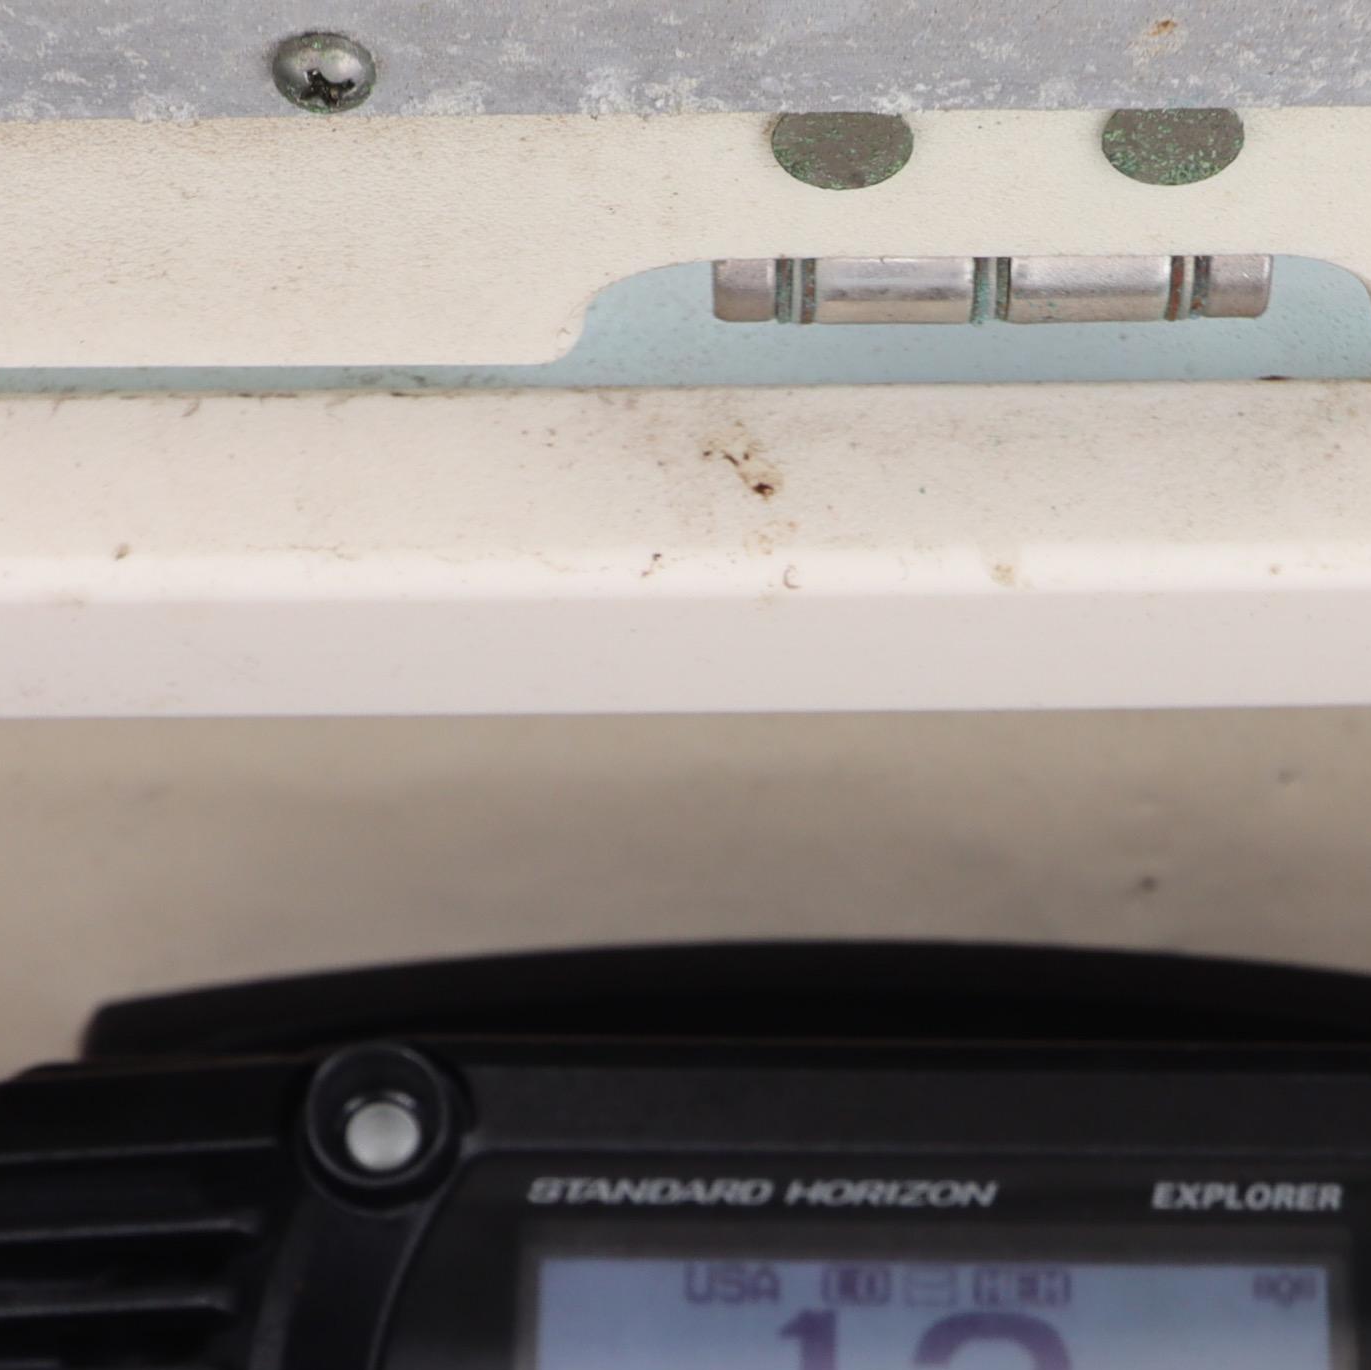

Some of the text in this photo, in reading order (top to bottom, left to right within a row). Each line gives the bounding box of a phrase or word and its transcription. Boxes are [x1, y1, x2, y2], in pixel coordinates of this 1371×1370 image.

[527, 1177, 999, 1208] STANDARD HORIZON
[1151, 1181, 1343, 1211] EXPLORER
[684, 1262, 782, 1305] USA
